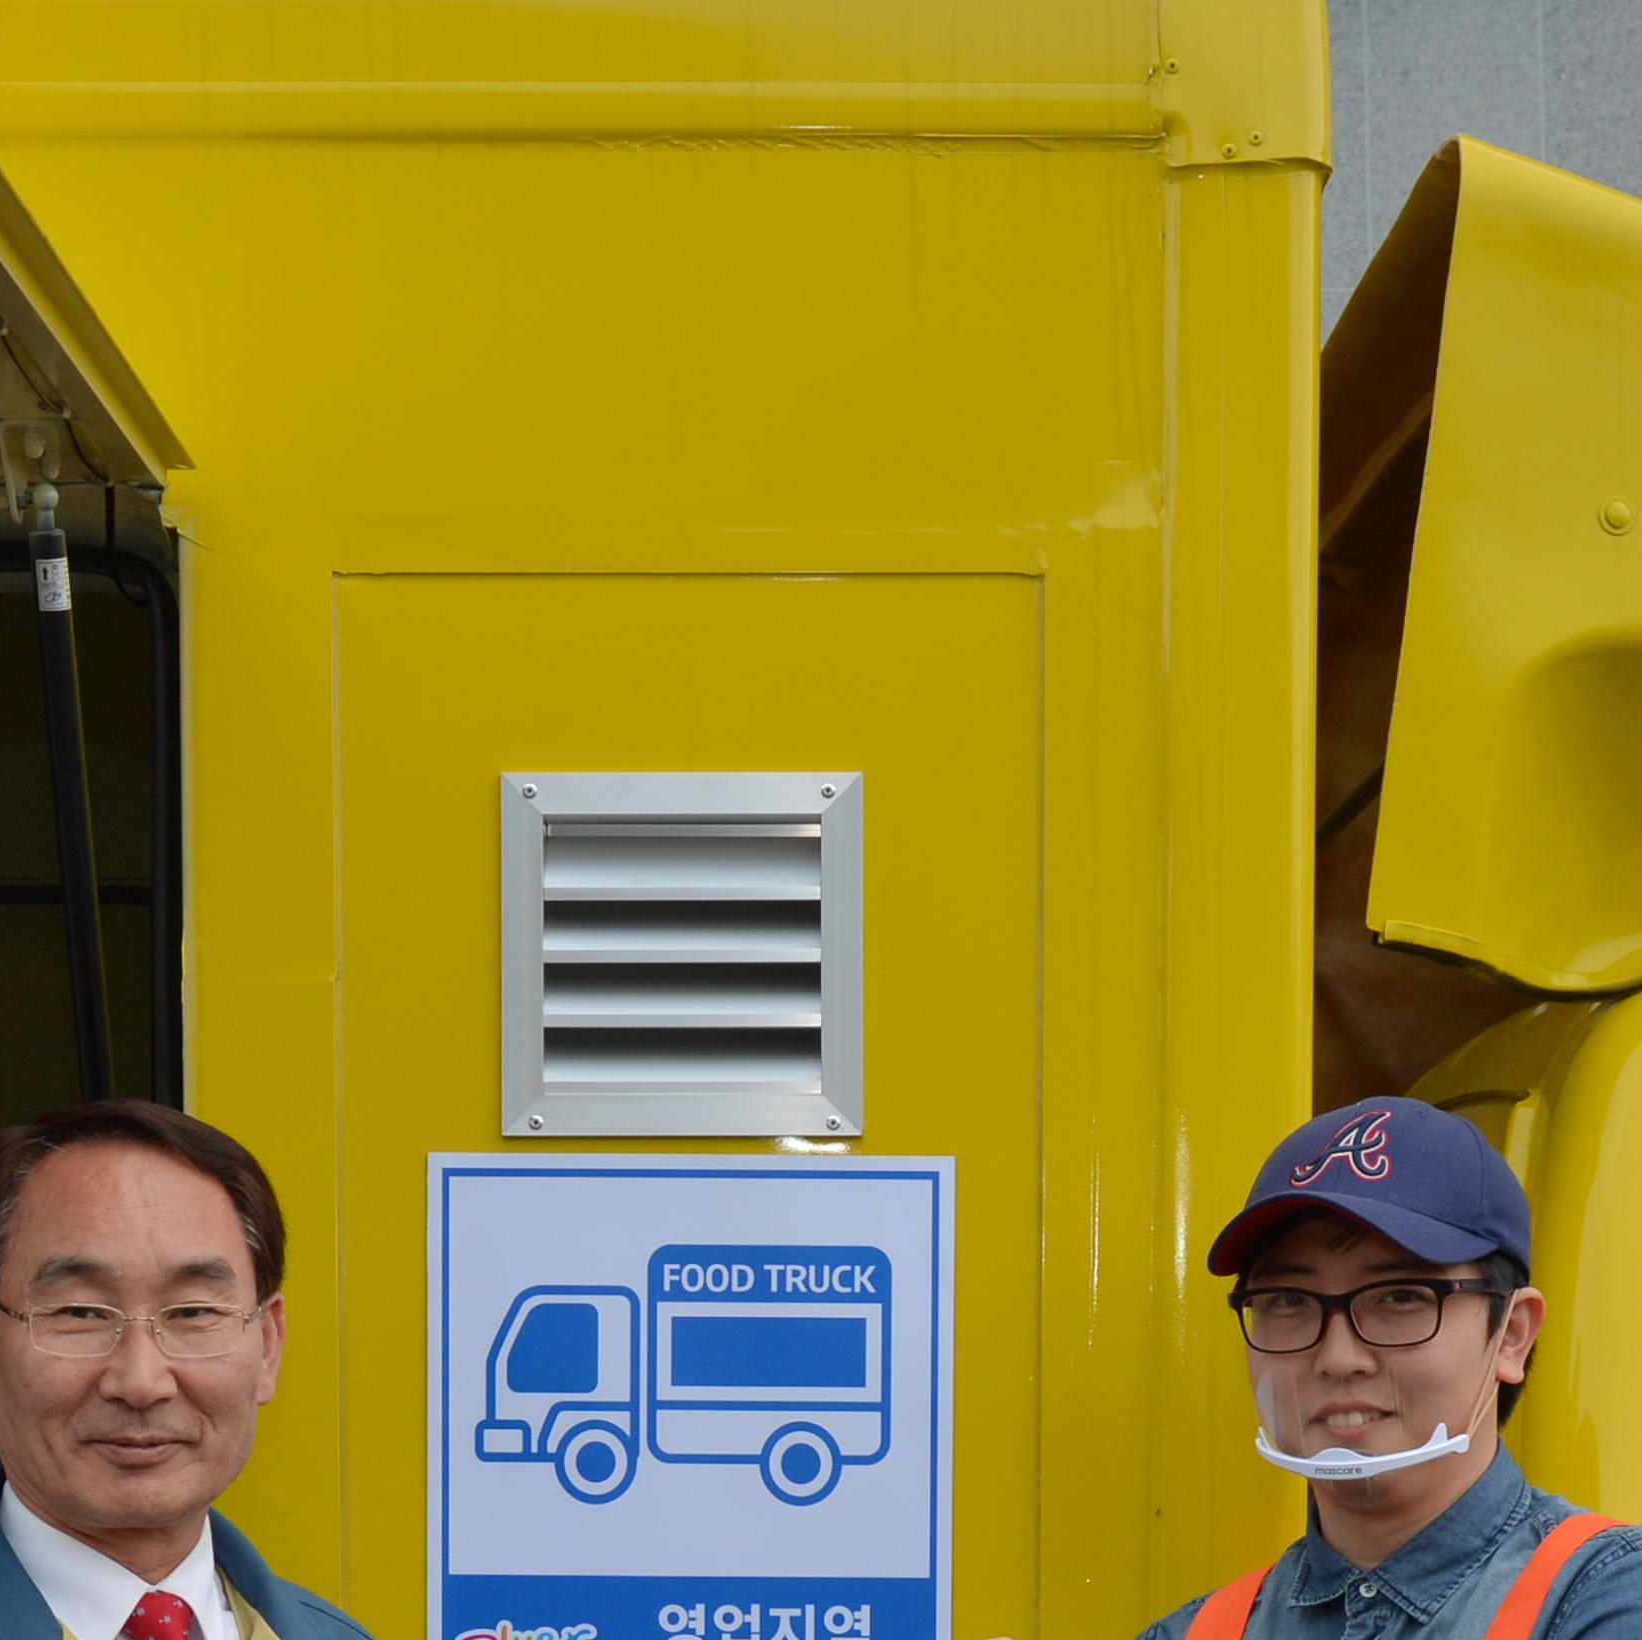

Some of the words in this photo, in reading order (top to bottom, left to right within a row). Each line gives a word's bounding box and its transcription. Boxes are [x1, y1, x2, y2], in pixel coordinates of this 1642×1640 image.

[1290, 1109, 1393, 1188] A
[663, 1263, 755, 1293] FOOD
[763, 1264, 876, 1294] TRUCK
